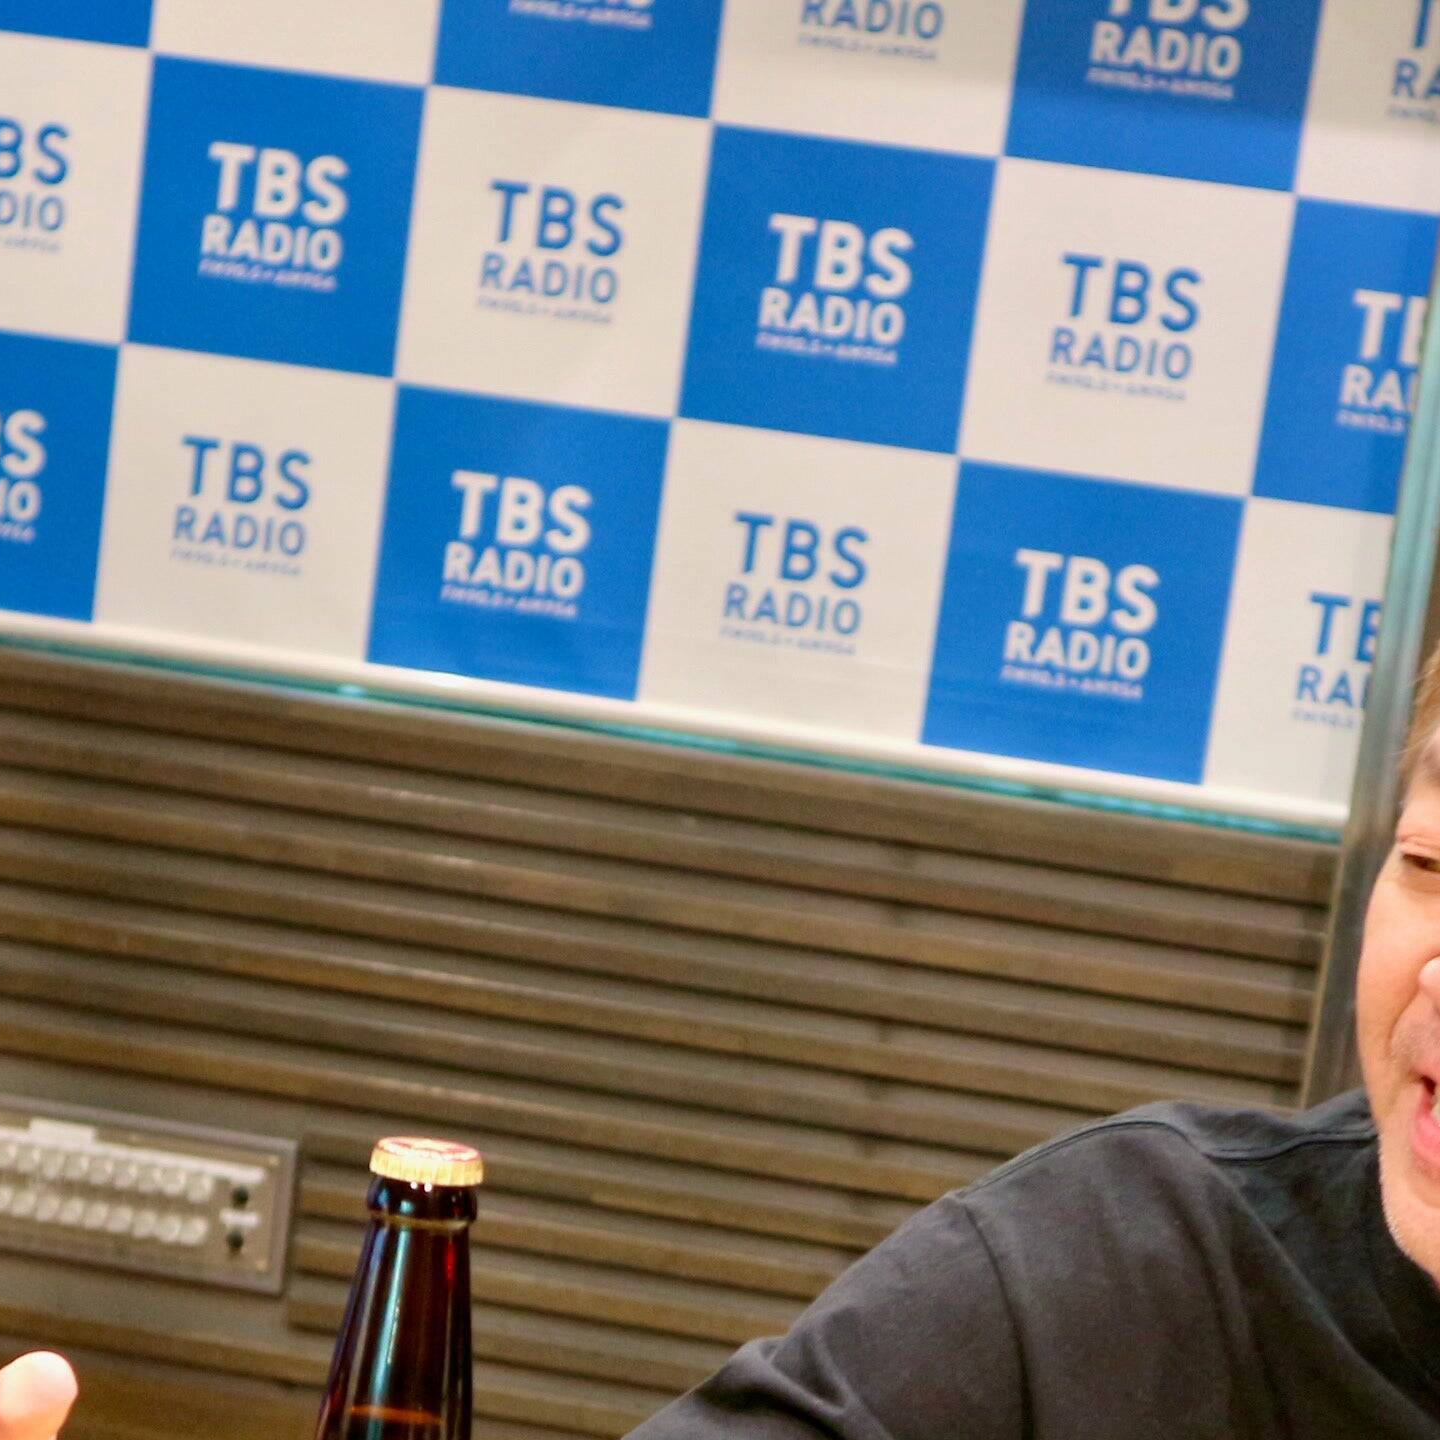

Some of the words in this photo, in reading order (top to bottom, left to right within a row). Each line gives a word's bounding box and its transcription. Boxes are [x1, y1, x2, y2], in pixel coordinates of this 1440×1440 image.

[799, 1, 942, 39] RADIO
[1090, 21, 1241, 77] RADIO
[209, 142, 348, 221] TBS
[200, 220, 342, 269] RADIO
[490, 181, 624, 257] TBS
[480, 253, 616, 303] RADIO
[769, 215, 913, 296] TBS
[761, 289, 903, 342] RADIO
[1063, 254, 1200, 332] TBS
[1051, 328, 1191, 380] RADIO
[182, 436, 312, 510] TBS
[175, 507, 305, 555] RADIO
[453, 471, 591, 550] TBS
[443, 544, 584, 597] RADIO
[735, 512, 868, 588] TBS
[724, 584, 861, 634] RADIO
[1016, 549, 1159, 633] TBS
[1004, 624, 1149, 676] RADIO
